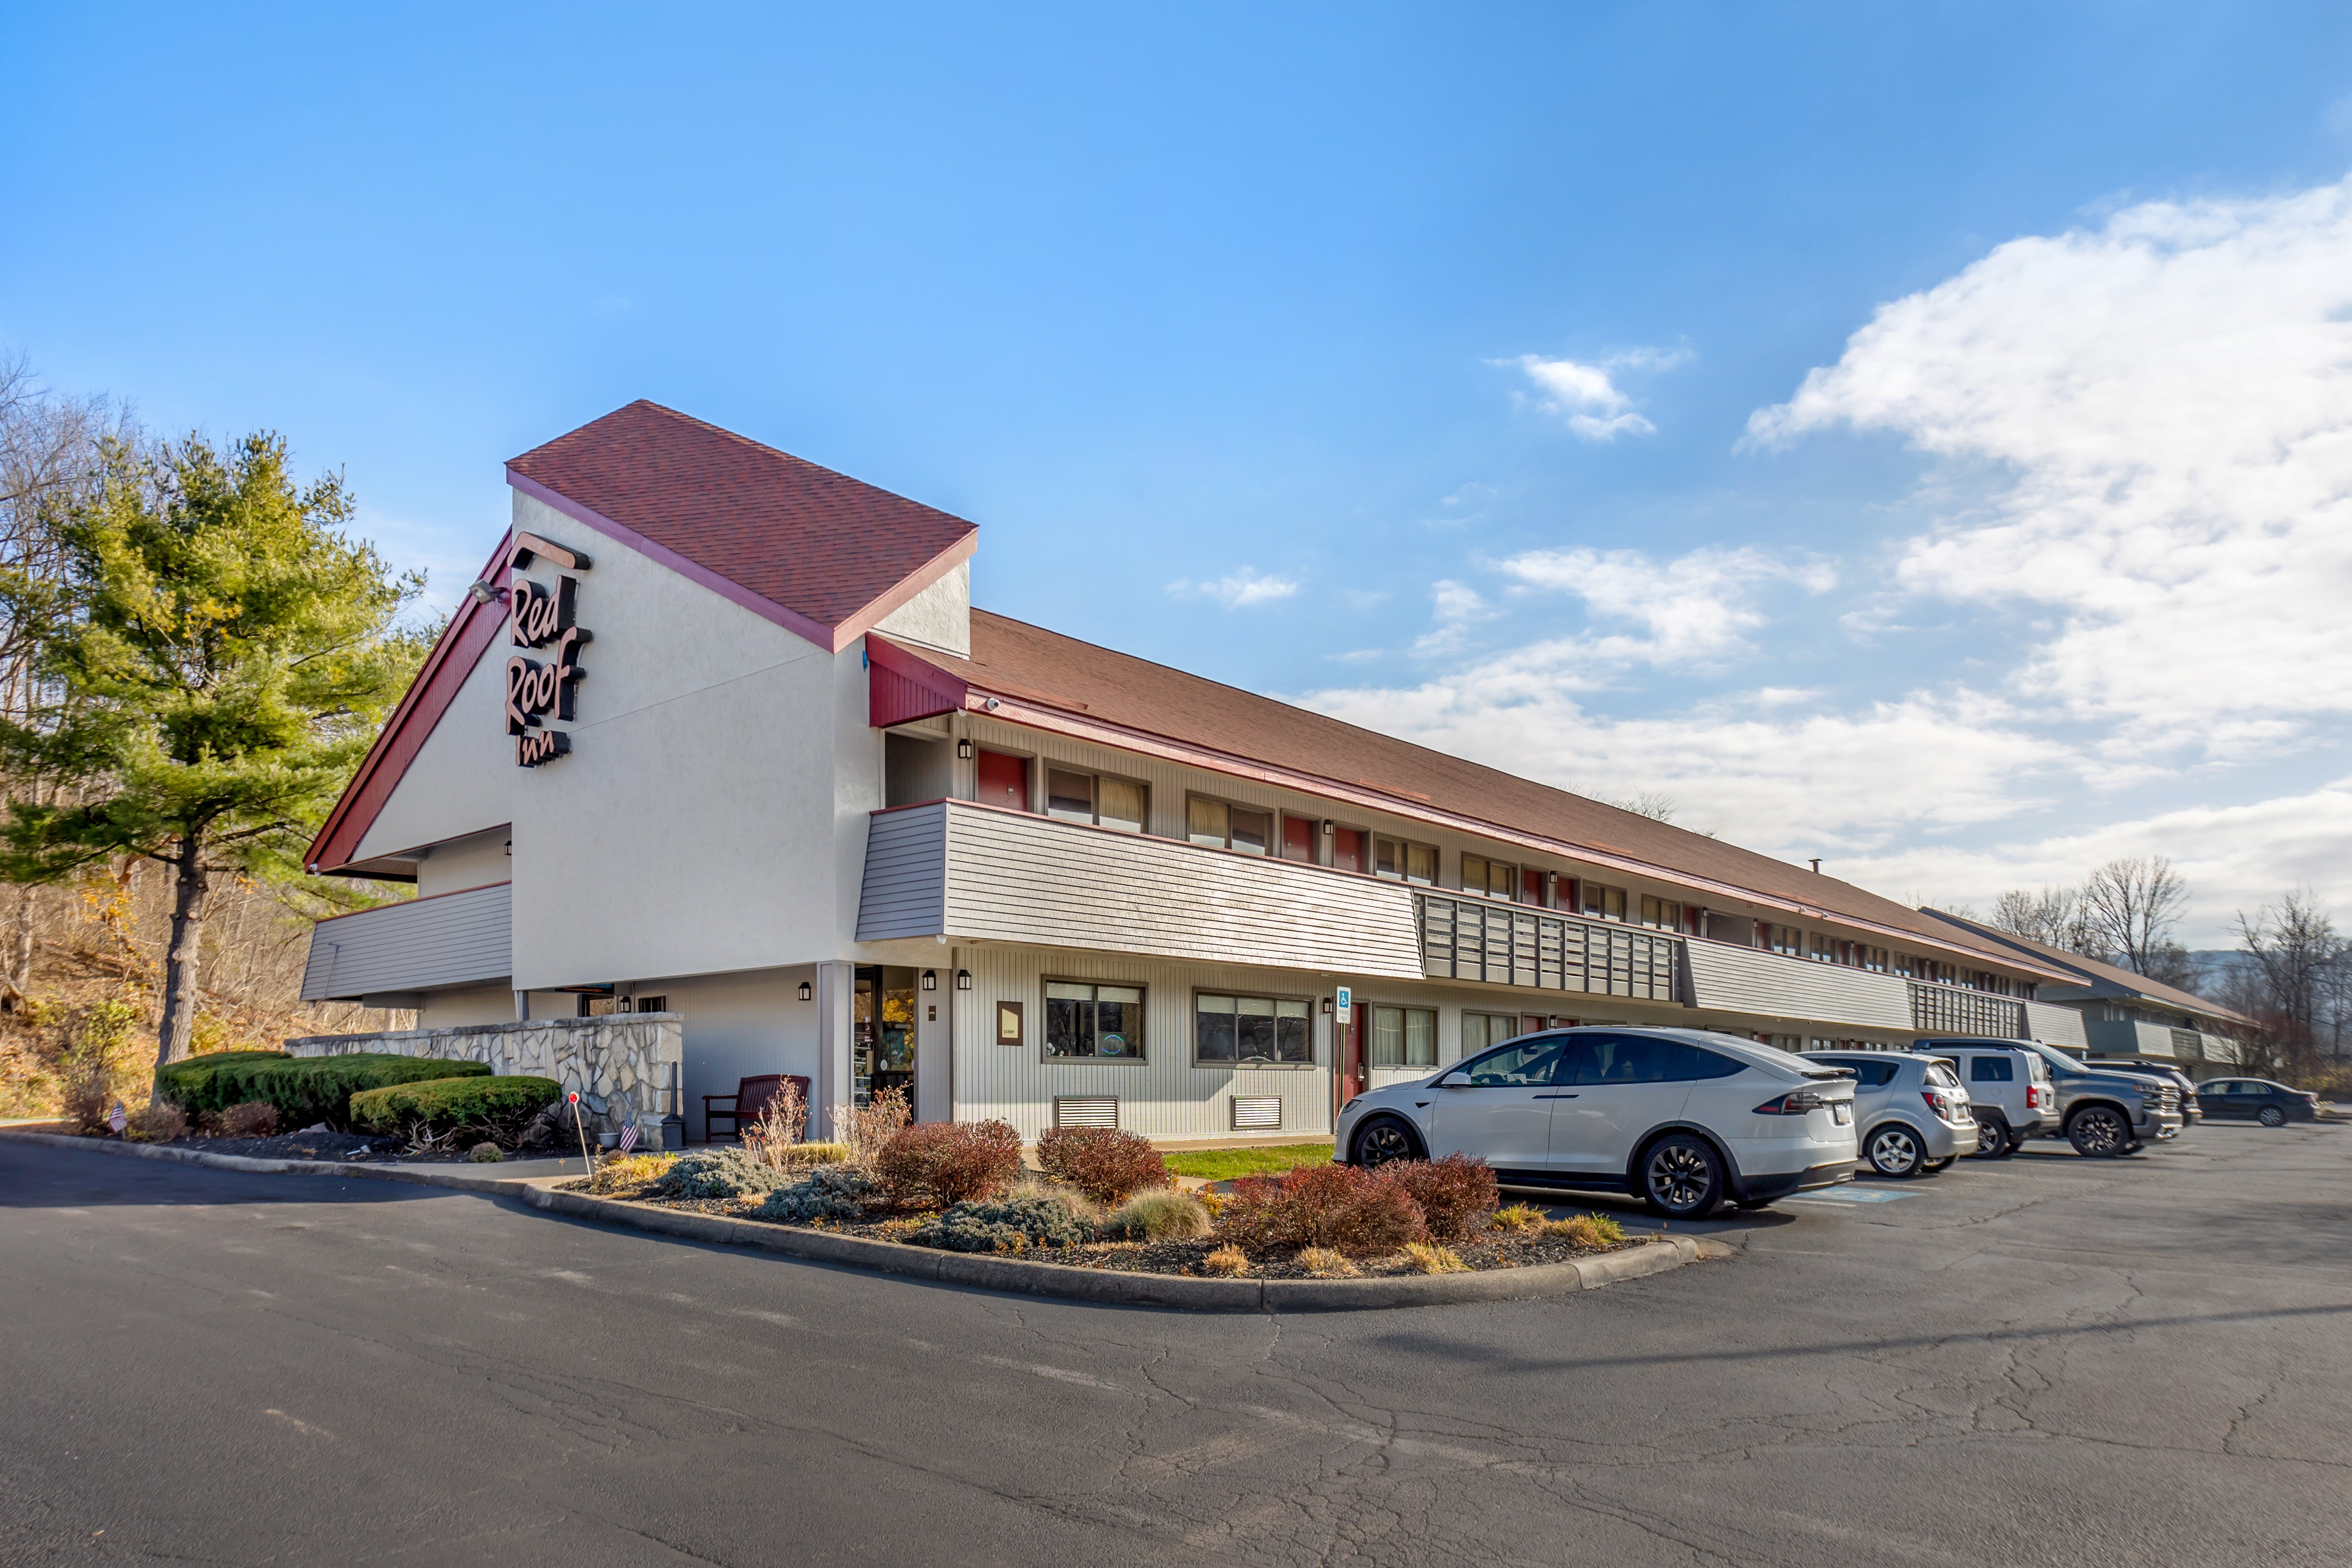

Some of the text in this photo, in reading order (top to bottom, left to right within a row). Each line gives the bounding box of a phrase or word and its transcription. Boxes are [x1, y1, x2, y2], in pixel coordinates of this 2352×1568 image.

[511, 575, 563, 646] Red
[505, 626, 577, 735] Roof
[516, 730, 555, 767] Inn
